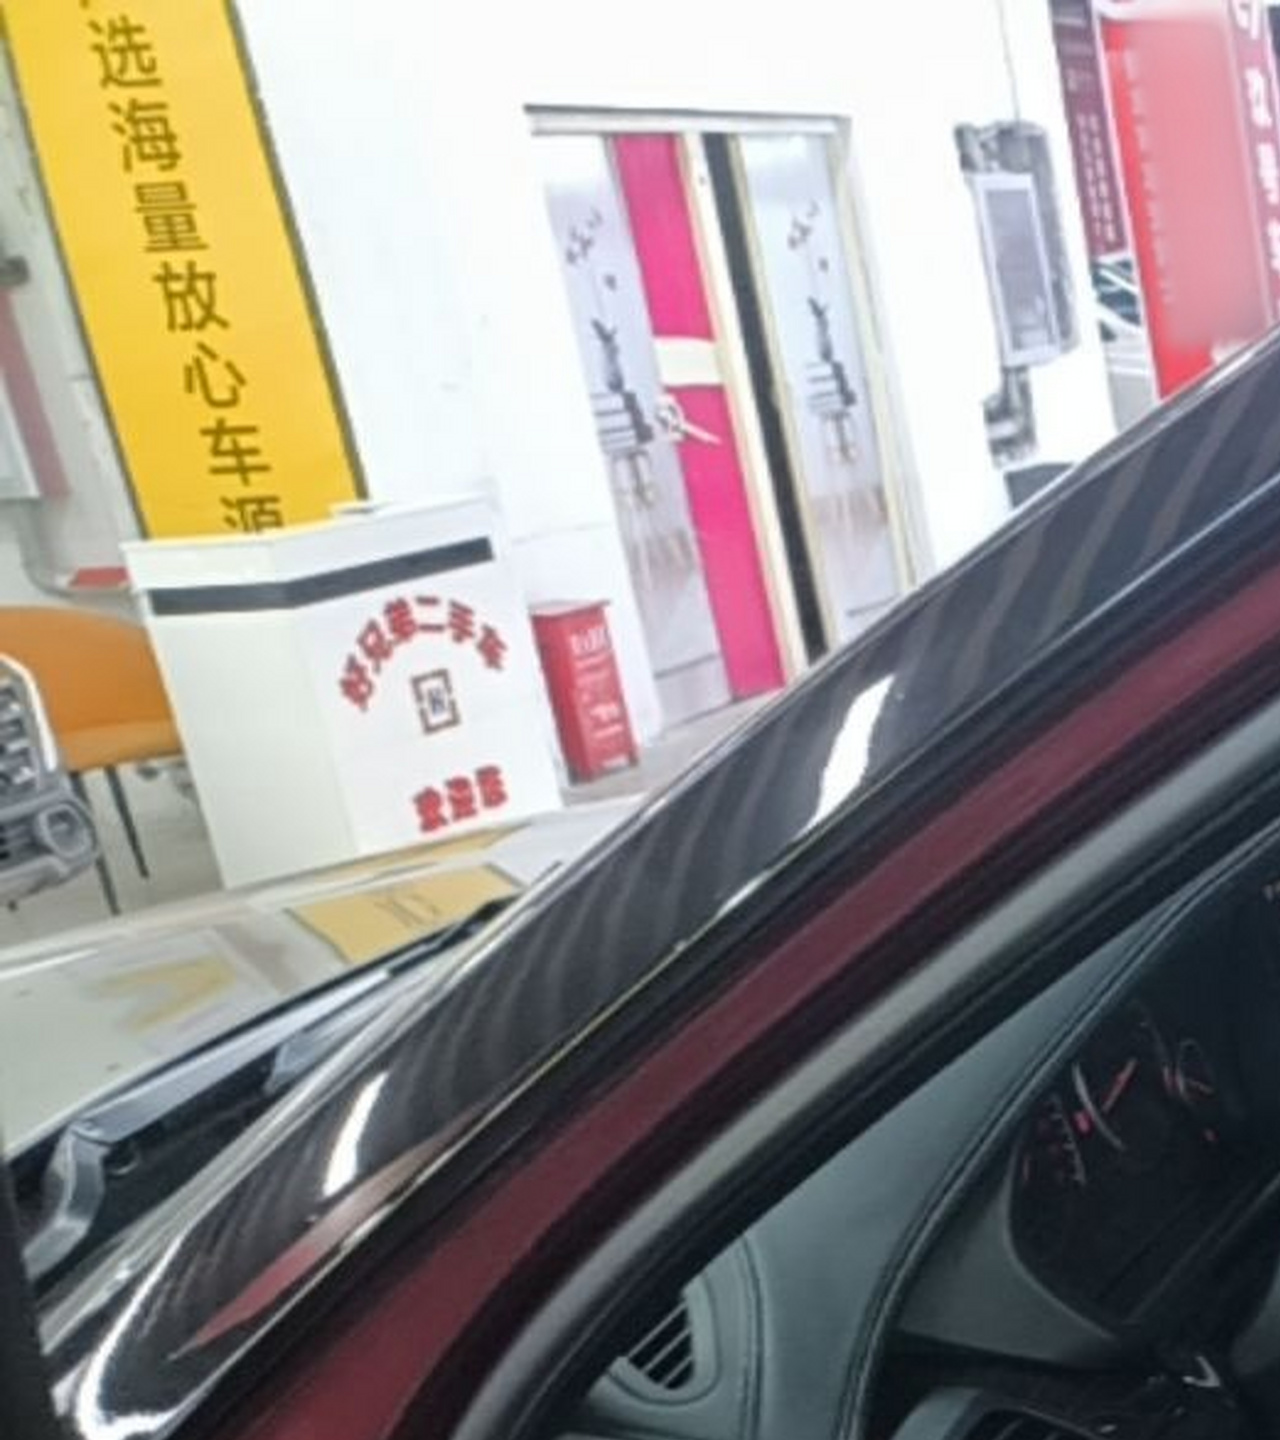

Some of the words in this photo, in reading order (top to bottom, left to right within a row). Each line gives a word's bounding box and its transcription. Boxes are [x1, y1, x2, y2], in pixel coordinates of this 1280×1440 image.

[80, 0, 284, 534] 选海量放心车源
